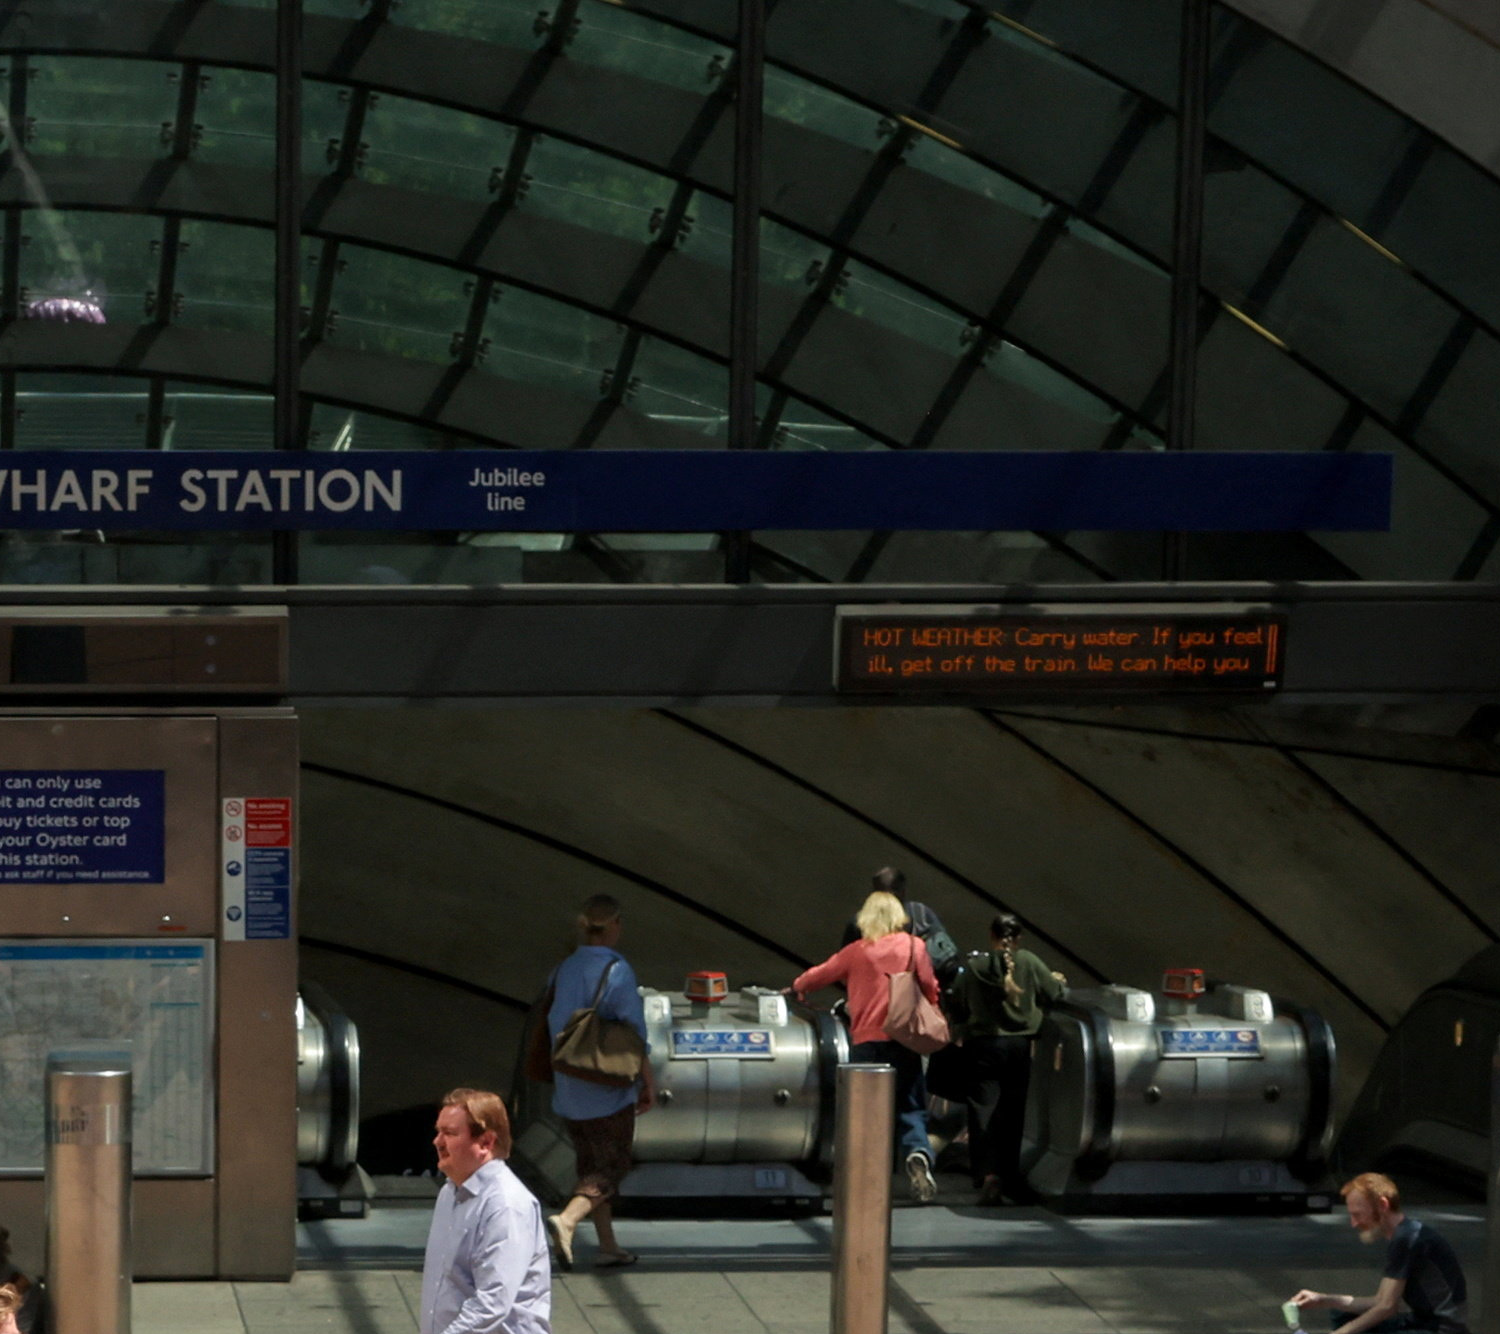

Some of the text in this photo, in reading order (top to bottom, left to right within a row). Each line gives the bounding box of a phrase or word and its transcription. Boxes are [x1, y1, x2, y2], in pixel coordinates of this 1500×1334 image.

[469, 468, 545, 486] Jubilee
[180, 469, 401, 512] STATION
[487, 493, 525, 511] line
[863, 628, 905, 646] HOT
[1015, 627, 1077, 649] Carry
[1178, 632, 1215, 648] you
[1223, 628, 1263, 645] feel
[901, 658, 933, 676] get
[939, 656, 975, 672] off
[984, 656, 1016, 672] the
[1088, 656, 1114, 671] We
[1120, 658, 1158, 672] can
[1163, 655, 1206, 673] help
[1213, 658, 1250, 674] you
[5, 778, 32, 789] can
[36, 776, 70, 791] only
[75, 778, 101, 789] use
[17, 795, 45, 808] and
[49, 795, 94, 808] credit
[99, 795, 140, 808] cards
[26, 815, 78, 827] tickets
[82, 817, 99, 827] or
[104, 816, 130, 829] top
[36, 833, 89, 849] Oyster
[93, 834, 126, 846] card
[25, 854, 82, 865] station.
